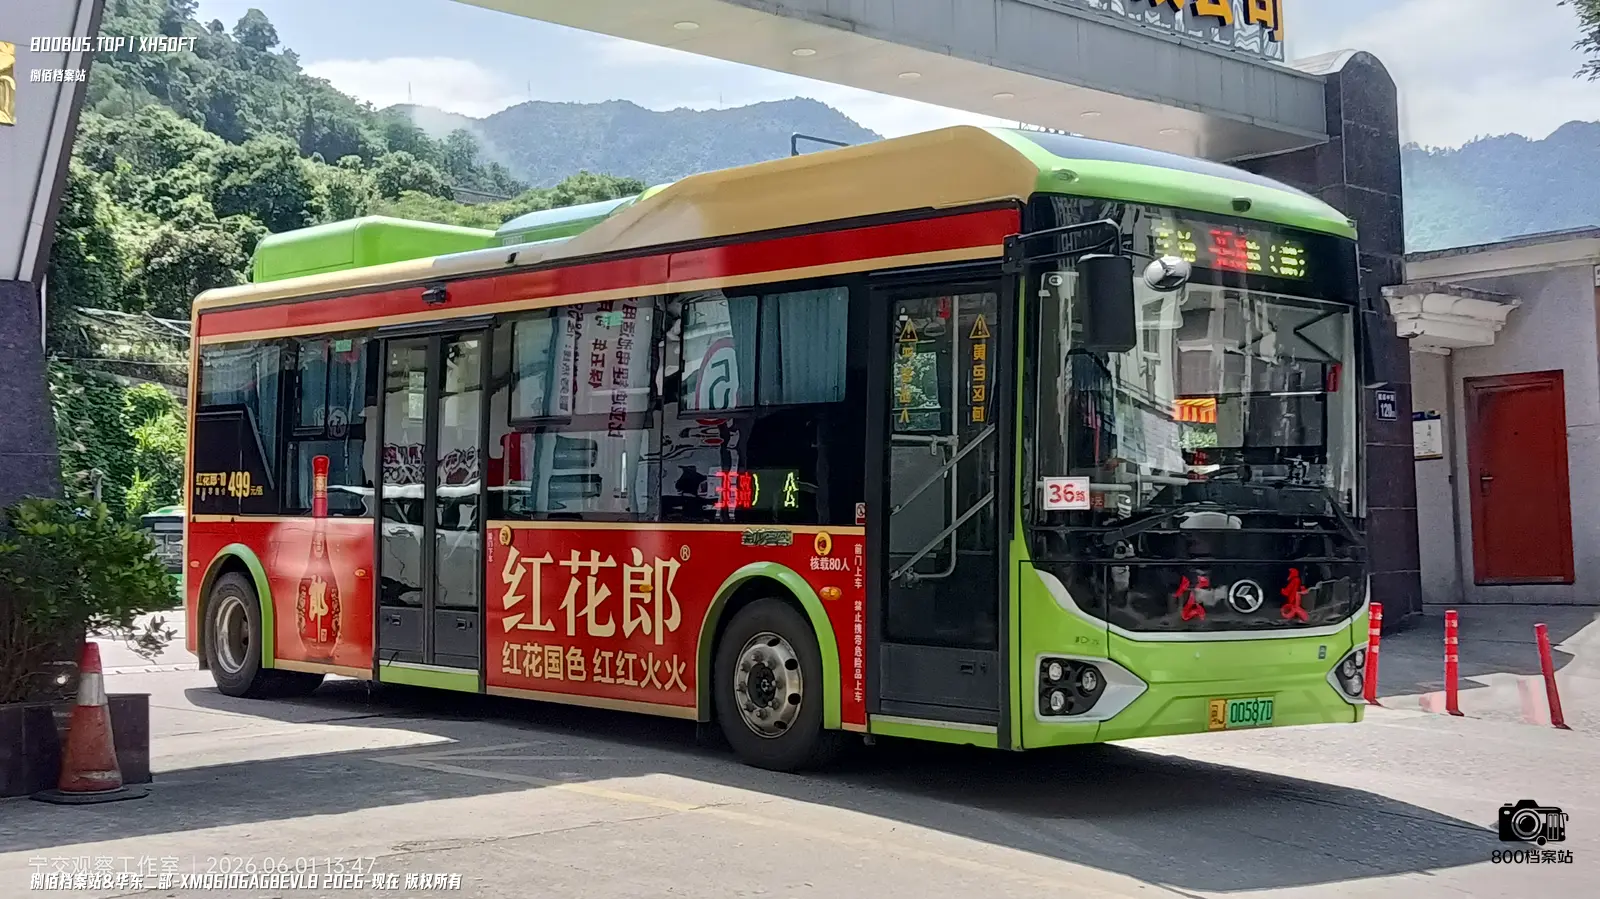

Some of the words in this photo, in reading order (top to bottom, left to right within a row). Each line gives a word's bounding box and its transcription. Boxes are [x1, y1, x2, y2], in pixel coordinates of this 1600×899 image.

[809, 555, 850, 572] 核载80人
[501, 545, 681, 646] 红花郎
[502, 641, 587, 681] 红花国色
[592, 648, 688, 692] 红红火火
[1230, 700, 1273, 723] 00587D
